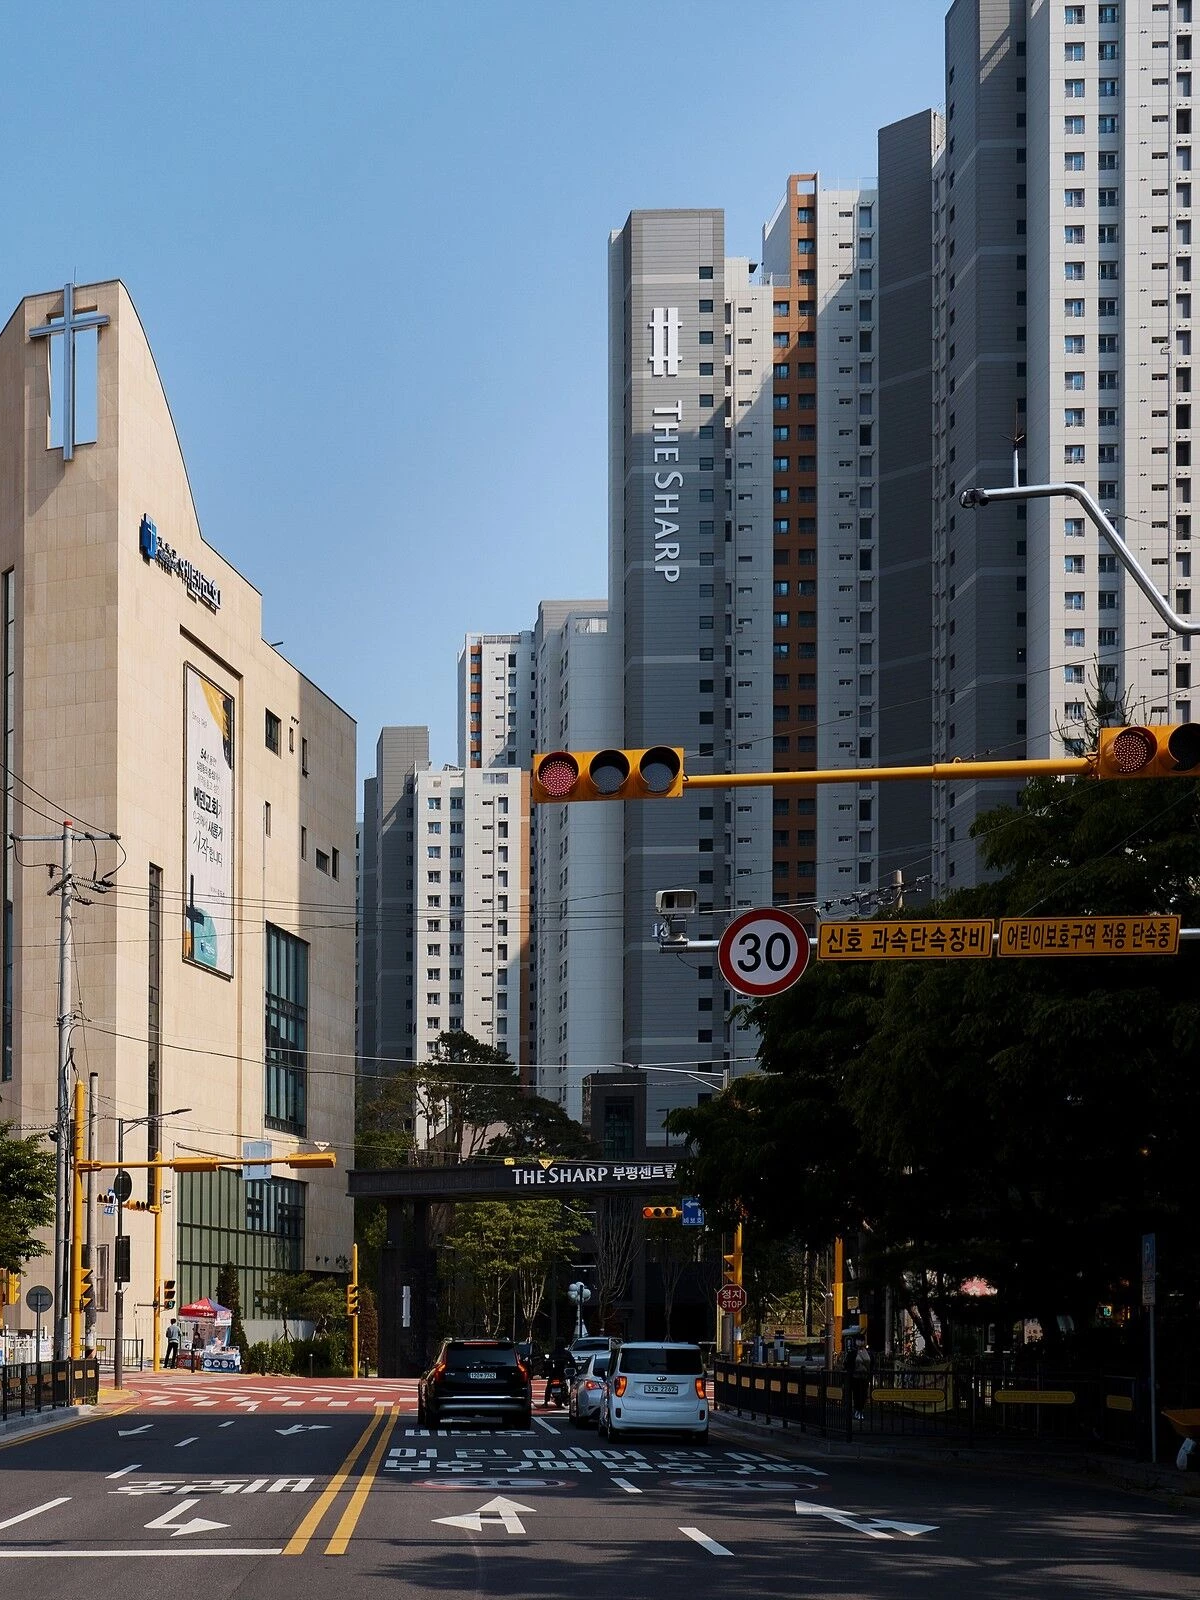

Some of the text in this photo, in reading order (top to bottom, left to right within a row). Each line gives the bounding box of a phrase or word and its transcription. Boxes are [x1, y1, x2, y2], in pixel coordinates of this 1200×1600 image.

[653, 471, 684, 583] SHARP
[826, 925, 986, 953] 신호 과속단속장비
[1006, 922, 1171, 950] 어린이보호구역 적용 단속중
[737, 931, 790, 973] 30
[512, 1168, 546, 1185] THE
[548, 1167, 608, 1183] SHARP
[722, 1289, 742, 1300] 정지
[722, 1300, 742, 1309] STOP
[405, 1429, 539, 1437] 비보호
[388, 1447, 592, 1459] 어린이
[587, 1449, 791, 1462] 어린이
[383, 1460, 593, 1473] 보호구역
[601, 1461, 830, 1476] 보호구역
